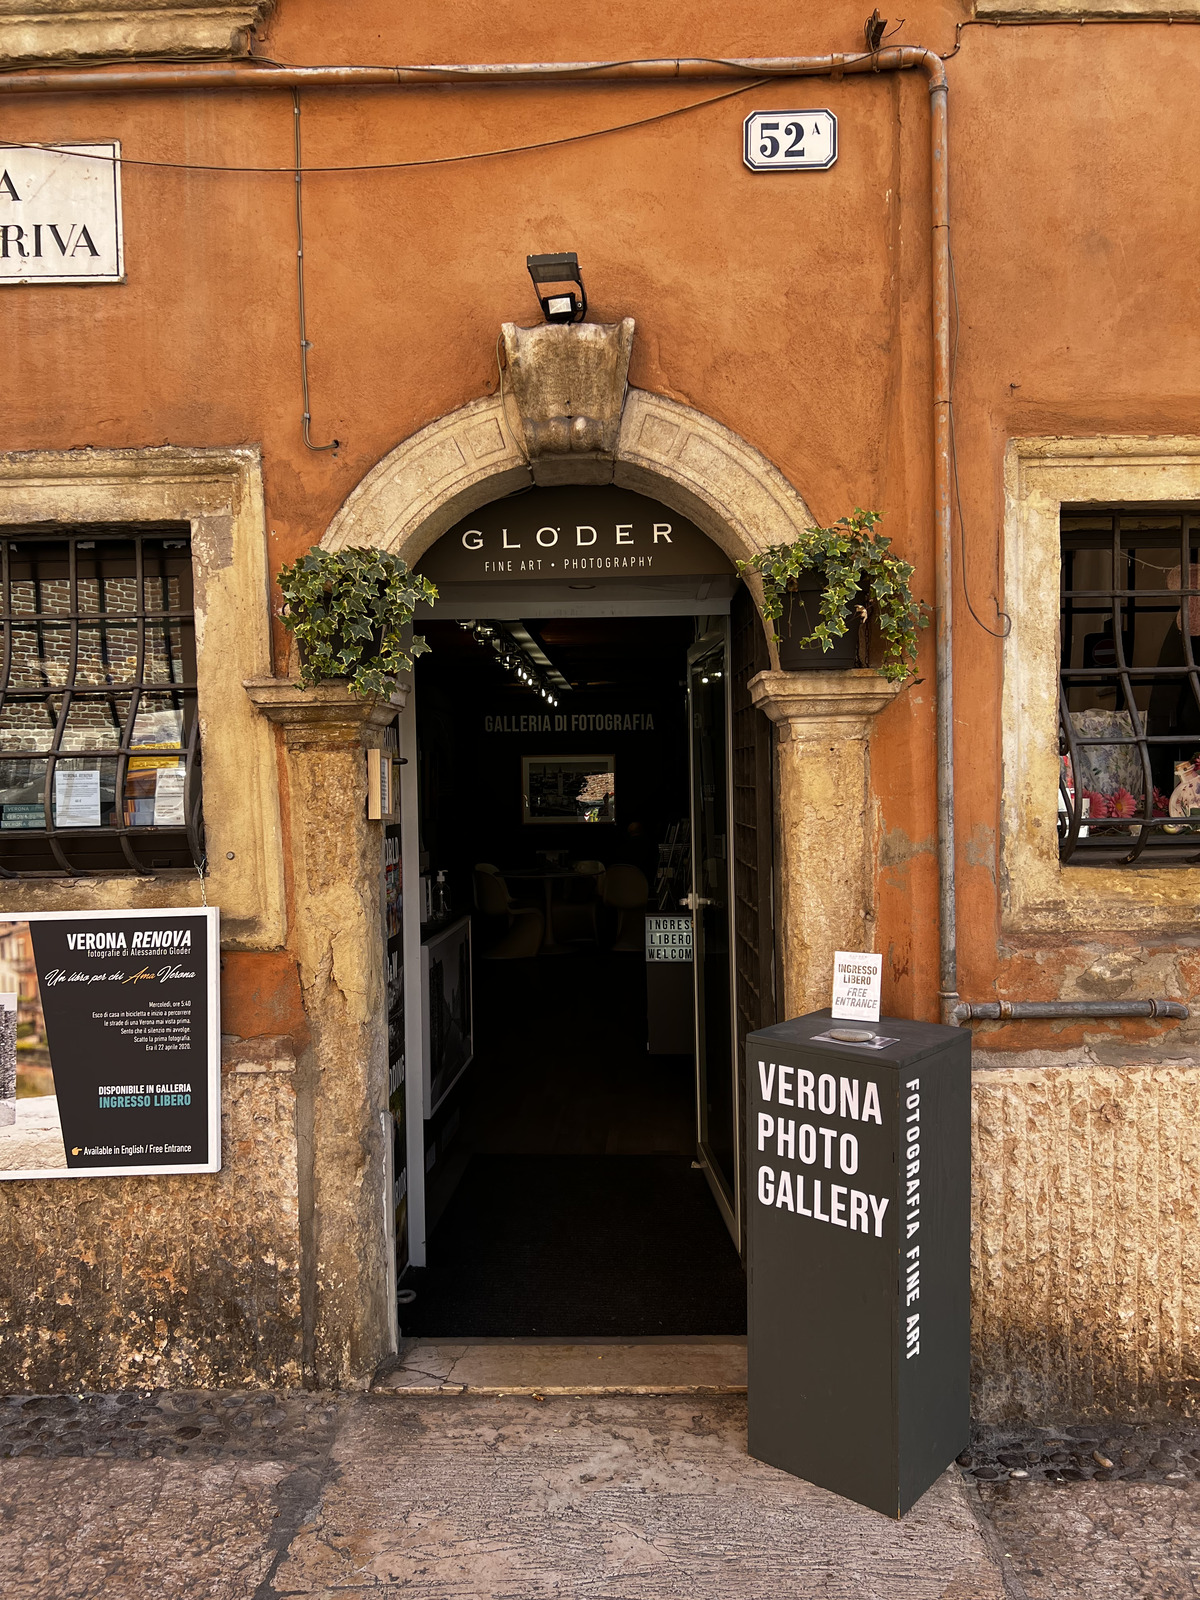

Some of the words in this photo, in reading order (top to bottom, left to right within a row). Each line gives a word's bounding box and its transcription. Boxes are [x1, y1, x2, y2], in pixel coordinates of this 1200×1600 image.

[0, 168, 22, 201] A
[485, 561, 512, 572] FINE
[520, 560, 542, 571] ART
[564, 556, 653, 569] PHOTOGRAPHY
[485, 715, 551, 732] GALLERIA
[554, 715, 568, 731] DI
[571, 714, 654, 731] FOTOGRAFIA
[67, 932, 127, 950] VERONA
[132, 930, 191, 948] RENOVA
[88, 949, 120, 958] fotografie
[131, 948, 167, 956] Alessandro
[170, 947, 191, 955] Gloder
[45, 969, 66, 986] Un
[68, 972, 90, 982] libro
[88, 974, 106, 984] per
[108, 971, 124, 981] chi
[122, 966, 155, 984] Ama
[157, 964, 196, 983] Verona
[838, 964, 878, 975] INGRESSO
[843, 974, 871, 985] LIBERO
[847, 988, 868, 998] FREE
[835, 997, 878, 1008] ENTRANCE
[98, 1085, 144, 1095] DISPONIBILE
[146, 1084, 154, 1094] IN
[156, 1084, 191, 1093] GALLERIA
[758, 1061, 882, 1125] VERONA
[99, 1096, 150, 1108] INGRESSO
[154, 1094, 191, 1106] LIBERO
[84, 1146, 112, 1155] Available
[114, 1146, 120, 1154] in
[121, 1145, 144, 1156] English
[145, 1145, 148, 1153] /
[149, 1144, 163, 1153] Free
[164, 1144, 192, 1153] Entrance
[758, 1112, 858, 1175] PHOTO
[906, 1078, 920, 1239] FOTOGRAFIA
[758, 1165, 889, 1238] GALLERY
[906, 1245, 920, 1307] FINE
[906, 1313, 920, 1360] ART
